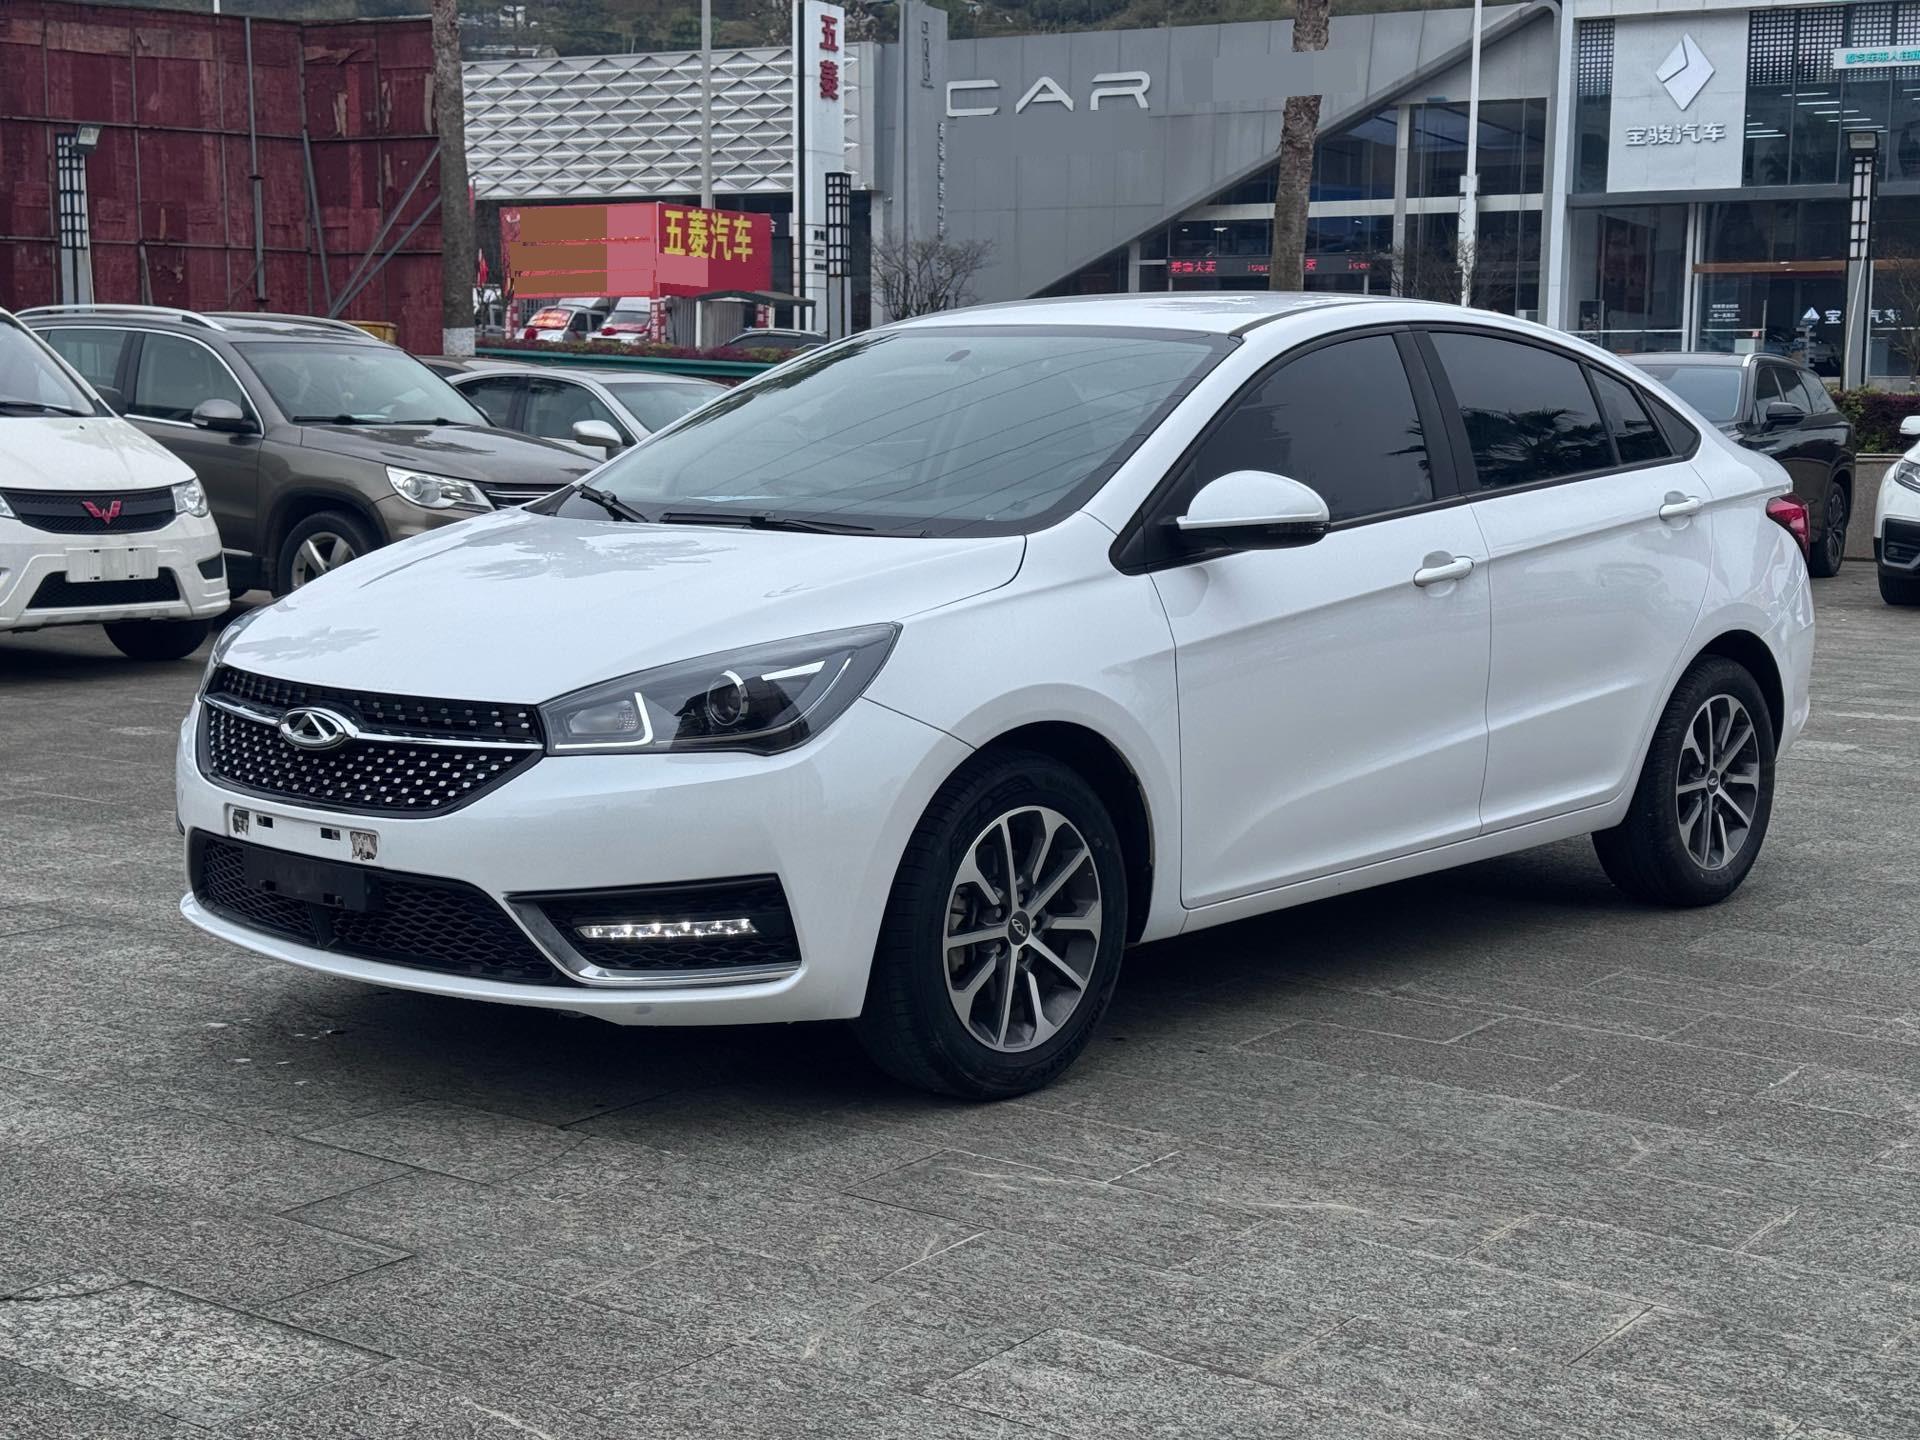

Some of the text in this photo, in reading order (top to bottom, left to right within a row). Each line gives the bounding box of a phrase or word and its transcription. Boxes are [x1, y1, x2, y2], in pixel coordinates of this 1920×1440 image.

[820, 14, 839, 101] 五菱
[946, 71, 1150, 117] CAR
[1625, 123, 1726, 146] 宝骏汽车
[664, 209, 753, 263] 五菱汽车
